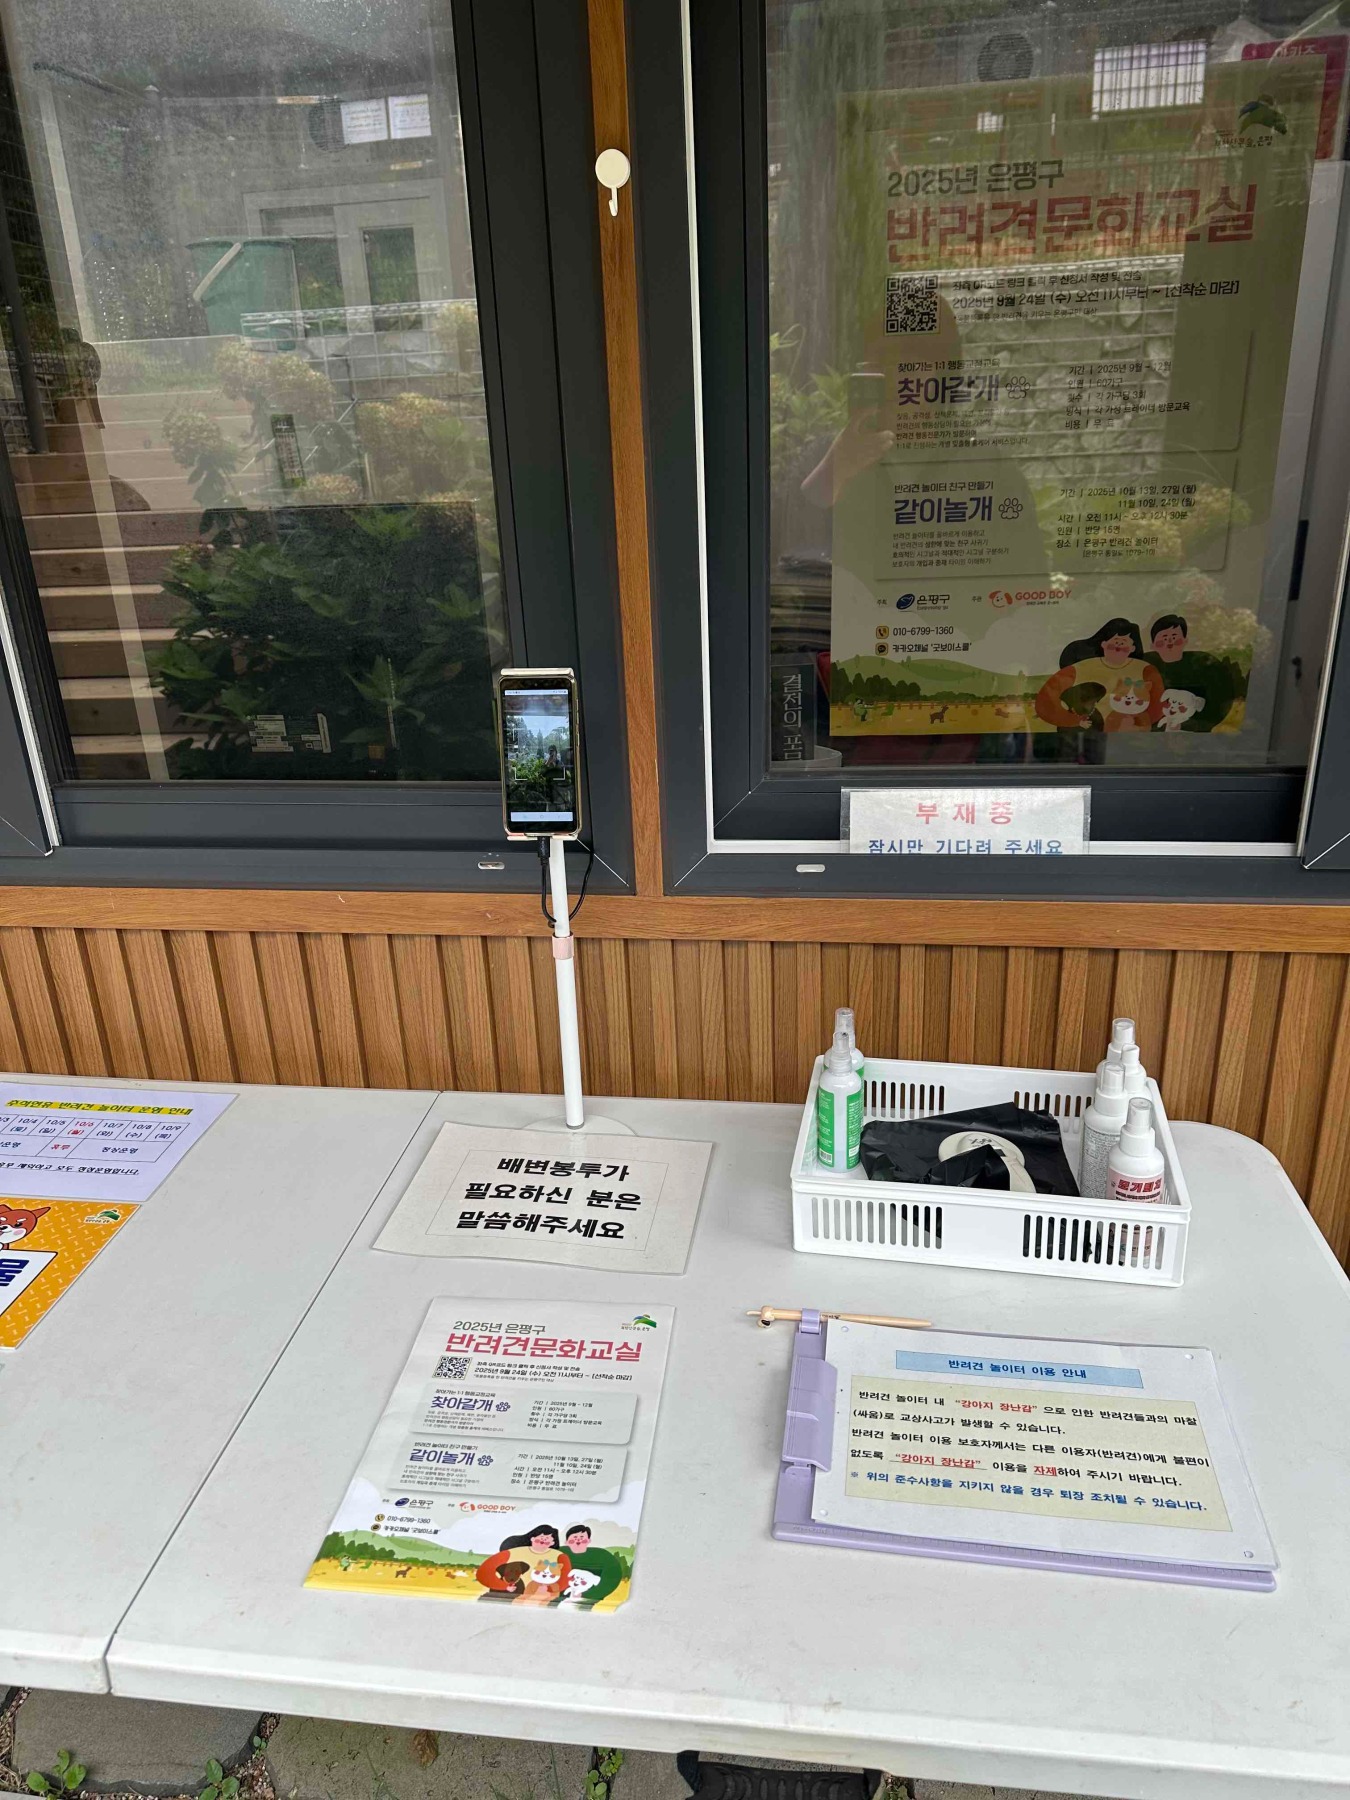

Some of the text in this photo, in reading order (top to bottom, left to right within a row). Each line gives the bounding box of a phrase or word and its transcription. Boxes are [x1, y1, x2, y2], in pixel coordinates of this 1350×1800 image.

[887, 159, 1064, 197] 2025년 은평구
[886, 184, 1258, 263] 반려견문화교실
[996, 295, 1016, 307] 9월
[1018, 294, 1046, 306] 24일
[1050, 292, 1071, 305] (수)
[1075, 290, 1099, 303] 오전
[1209, 280, 1240, 295] 마감]
[898, 361, 933, 373] 찾아가는
[934, 361, 946, 371] 1:1
[1069, 365, 1085, 376] 기간
[1098, 363, 1127, 374] 2025년
[1129, 362, 1143, 373] 9월
[897, 373, 1001, 406] 찾아갈개
[1158, 401, 1191, 412] 방문교육
[894, 480, 994, 494] 반려견 놀이터 친구 만들기
[1060, 487, 1076, 498] 기간
[1087, 486, 1116, 497] 2025년
[1119, 485, 1136, 496] 10월
[1161, 484, 1180, 495] 27일
[1182, 483, 1197, 494] (월)
[894, 495, 994, 525] 같이놀개
[1118, 498, 1136, 509] 11월
[1161, 497, 1179, 508] 24일
[1181, 497, 1196, 508] (월)
[1058, 512, 1074, 523] 시간
[1086, 512, 1102, 523] 오전
[1104, 511, 1122, 522] 11시
[1057, 525, 1073, 536] 인원
[1056, 535, 1159, 548] 장소 은평구 반려견 놀이터
[916, 594, 950, 605] 은평구
[1015, 590, 1072, 601] GOOD BOY
[893, 626, 954, 637] 010-6799-1360
[892, 643, 929, 653] 카카오채널
[783, 673, 803, 728] 결전의
[915, 801, 1014, 825] 부 재 중
[868, 838, 1064, 855] 잠시만 기다려 주세요
[59, 1102, 96, 1112] 반려견
[99, 1104, 135, 1113] 놀이터
[170, 1107, 194, 1116] 안내
[18, 1117, 183, 1132] 10/4 10/5 10/6 10/7 10/8 10/9
[39, 1126, 57, 1134] (일)
[67, 1127, 85, 1136] (월)
[96, 1130, 114, 1138] (화)
[125, 1131, 144, 1139] (수)
[497, 1158, 630, 1182] 배변봉투가
[464, 1182, 641, 1211] 필요하신 분은
[456, 1211, 625, 1240] 말씀해주세요
[453, 1320, 546, 1335] 2025년 은평구
[445, 1333, 643, 1362] 반려견문화교실
[949, 1360, 1087, 1379] 반려견 놀이터 이용 안내
[431, 1396, 494, 1412] 찾아갈개
[859, 1391, 890, 1401] 반려견
[896, 1394, 928, 1405] 놀이터
[934, 1397, 945, 1406] 내
[1043, 1406, 1066, 1416] 으로
[1071, 1408, 1094, 1418] 인한
[1100, 1410, 1169, 1425] 반려견들과의
[1174, 1416, 1198, 1426] 마찰
[853, 1409, 1066, 1435] (싸움)로 교상사고가 발생할 수 있습니다.
[852, 1428, 1210, 1467] 반려견 놀이터 이용 보호자께서는 다른 이용자(반려견)에게 불편이
[409, 1448, 476, 1466] 같이놀개
[851, 1449, 884, 1460] 없도록
[992, 1461, 1028, 1473] 이용을
[1033, 1465, 1081, 1478] 자제하여
[1086, 1469, 1123, 1482] 주시기
[1129, 1474, 1182, 1486] 바랍니다.
[866, 1471, 1207, 1511] 위의 준수사항을 지키지 않을 경우 퇴장 조치될 수 있습니다.
